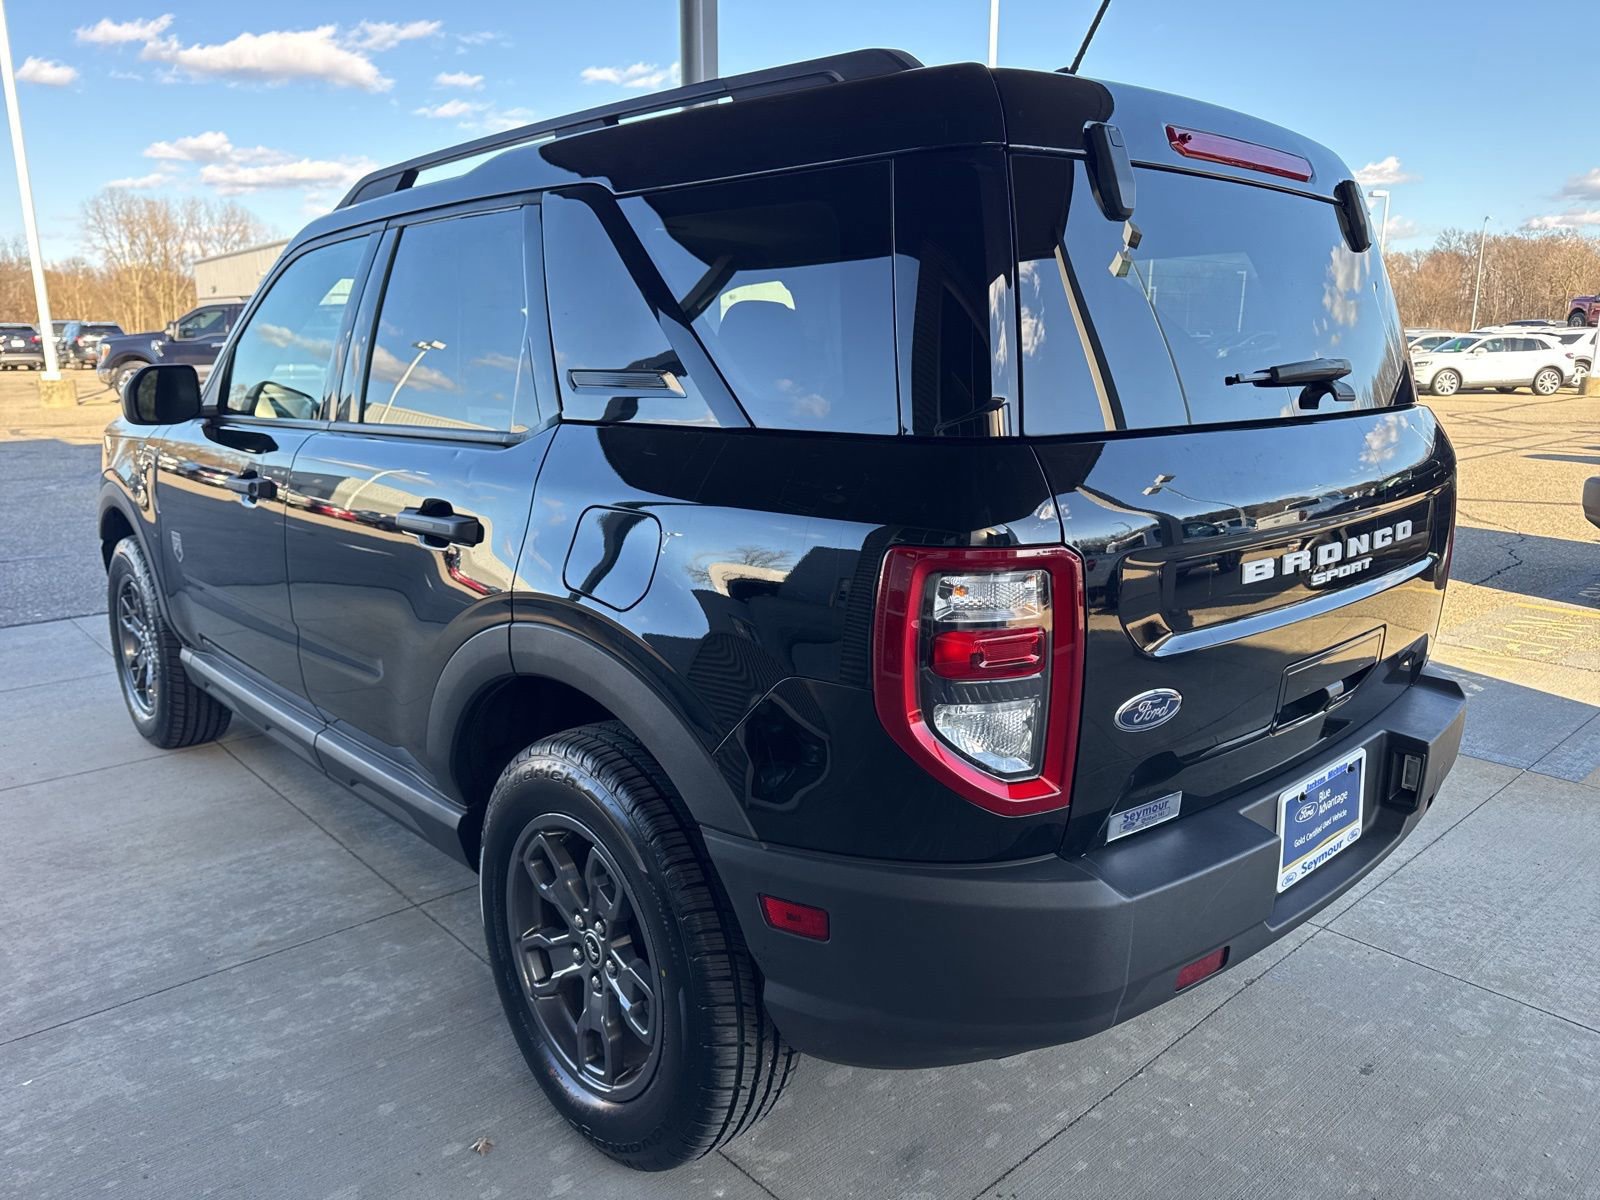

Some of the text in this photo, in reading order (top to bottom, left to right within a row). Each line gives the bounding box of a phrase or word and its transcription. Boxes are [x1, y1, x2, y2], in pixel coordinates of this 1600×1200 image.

[1241, 519, 1412, 585] BRONCO
[1310, 557, 1373, 586] SPORT
[1318, 788, 1331, 803] Blue
[1318, 790, 1349, 816] Advantage
[1122, 800, 1170, 823] Seymour
[1293, 835, 1306, 848] Gold
[1322, 817, 1332, 830] Used
[1332, 808, 1348, 823] Vehicle
[1300, 839, 1344, 874] Seymour
